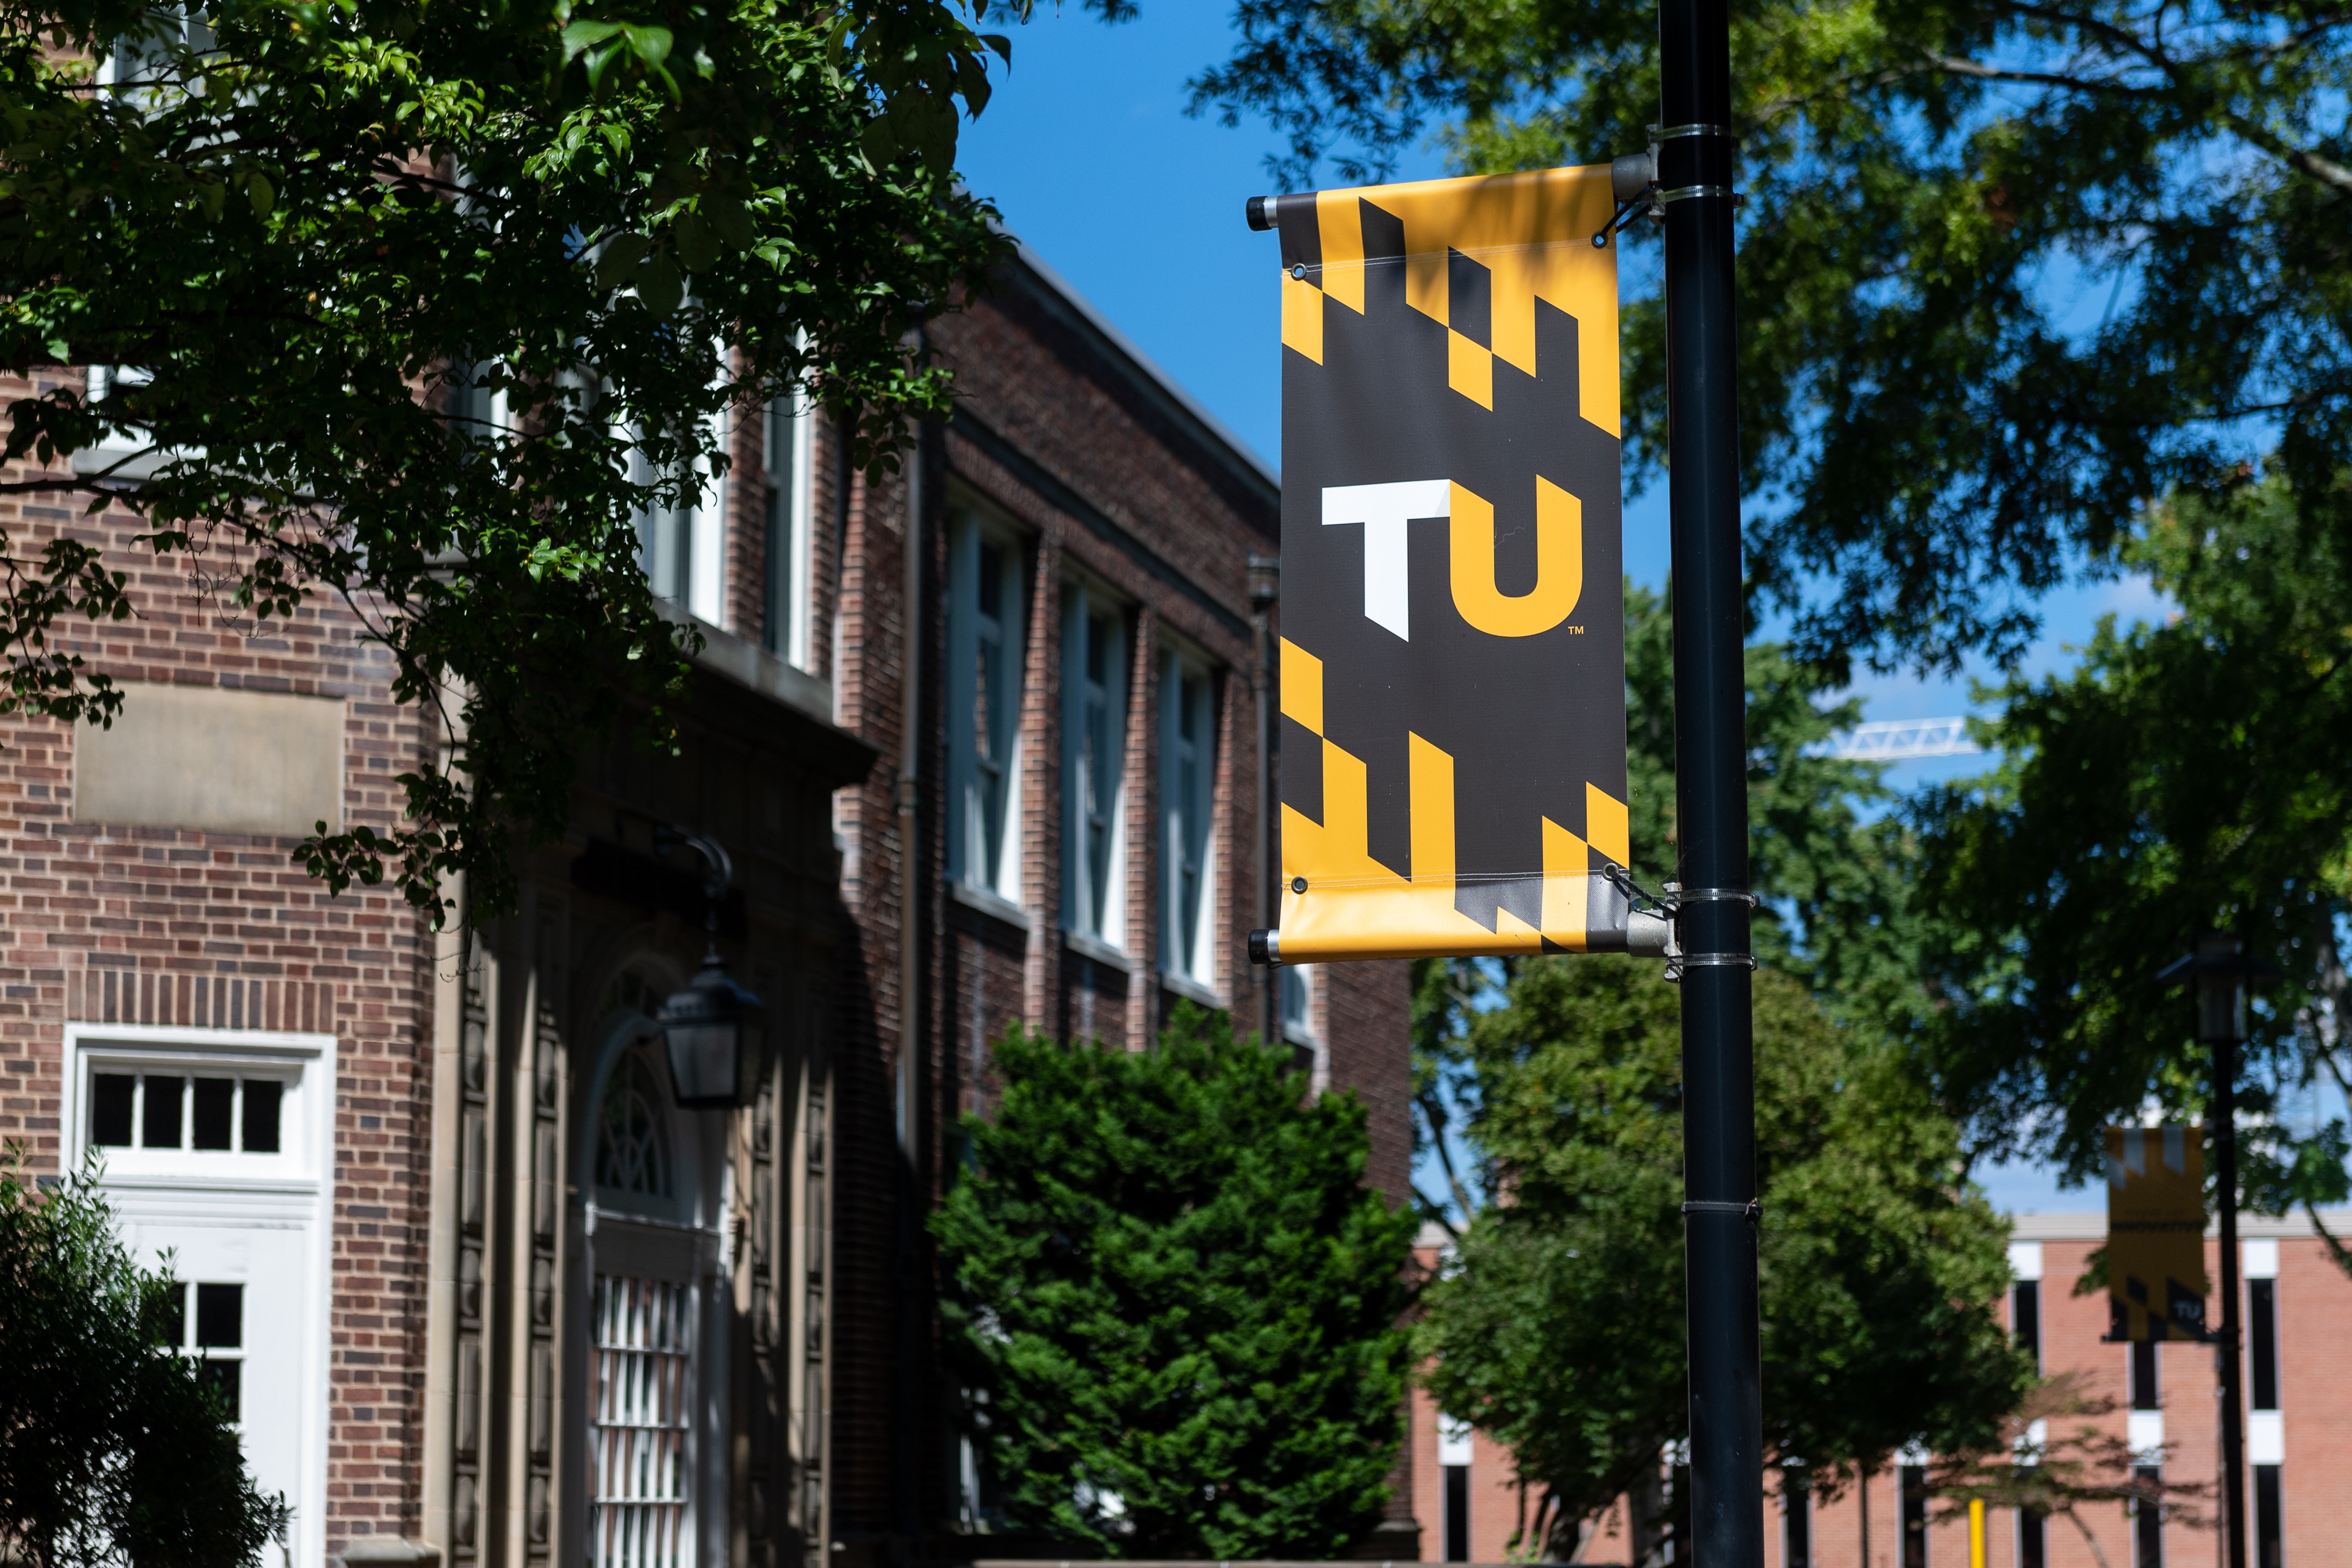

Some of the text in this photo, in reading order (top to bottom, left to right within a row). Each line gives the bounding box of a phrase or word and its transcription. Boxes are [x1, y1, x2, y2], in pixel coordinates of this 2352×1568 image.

[1322, 474, 1583, 642] TU
[1567, 626, 1584, 635] TM
[2173, 1299, 2201, 1320] TU
